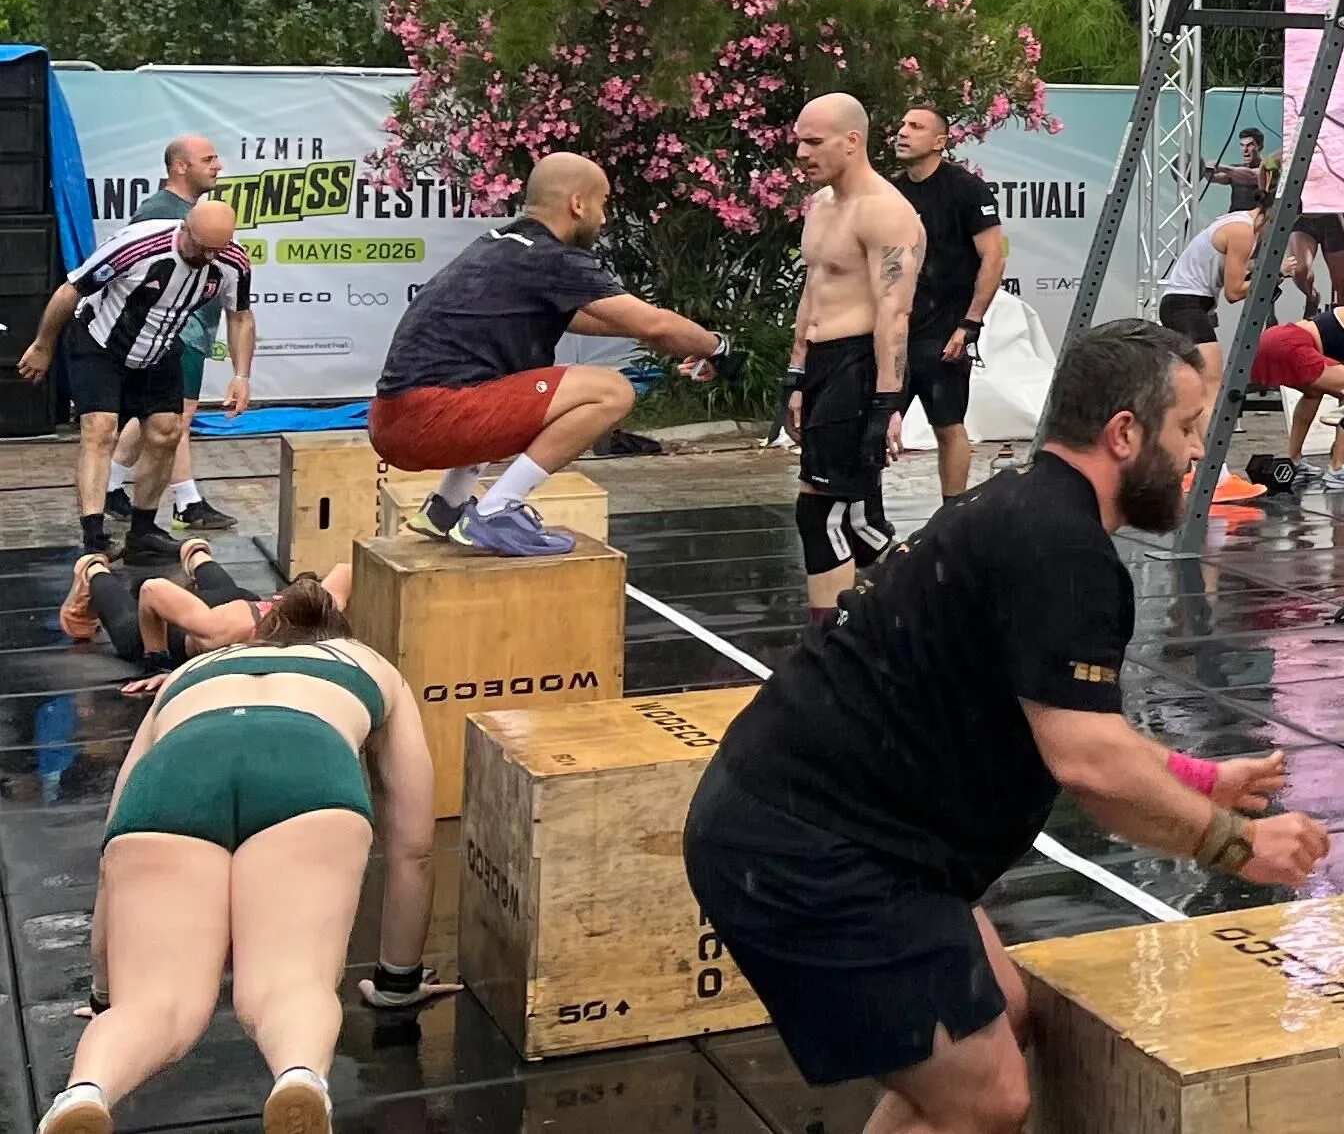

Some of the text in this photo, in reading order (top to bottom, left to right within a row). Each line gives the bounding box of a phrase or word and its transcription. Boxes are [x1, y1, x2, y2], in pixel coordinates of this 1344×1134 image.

[366, 243, 416, 259] 2026
[249, 291, 332, 304] ODECO
[422, 671, 599, 702] WODECO
[631, 702, 720, 748] WODECO
[558, 1000, 608, 1025] 50
